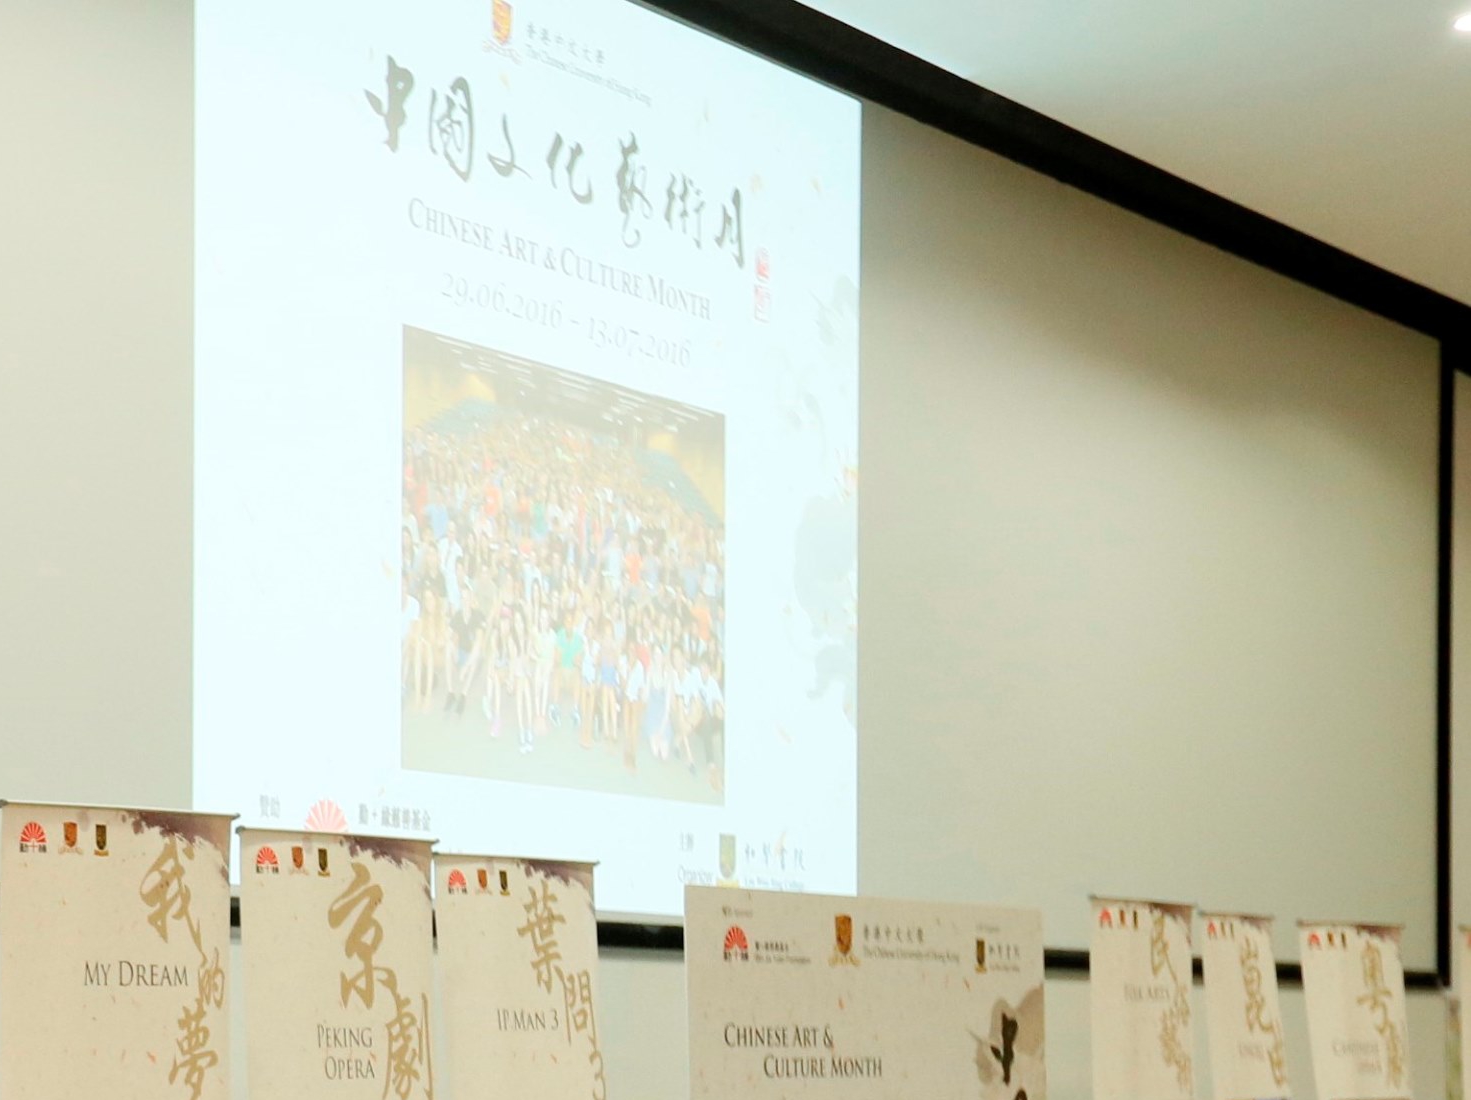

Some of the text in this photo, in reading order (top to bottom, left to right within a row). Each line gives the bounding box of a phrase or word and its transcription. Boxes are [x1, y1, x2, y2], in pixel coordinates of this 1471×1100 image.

[408, 198, 496, 253] CHINESE
[501, 236, 542, 271] ART
[543, 249, 558, 271] &
[561, 246, 644, 301] CULTURE
[647, 276, 713, 322] MONTH
[84, 960, 189, 988] MY DREAM
[513, 1008, 546, 1031] MAN
[550, 1008, 559, 1031] 3
[316, 1023, 373, 1048] PEKING
[724, 1023, 834, 1049] CHINESE ART &
[324, 1056, 376, 1080] OPERA
[763, 1056, 883, 1079] CULTURE MONTH
